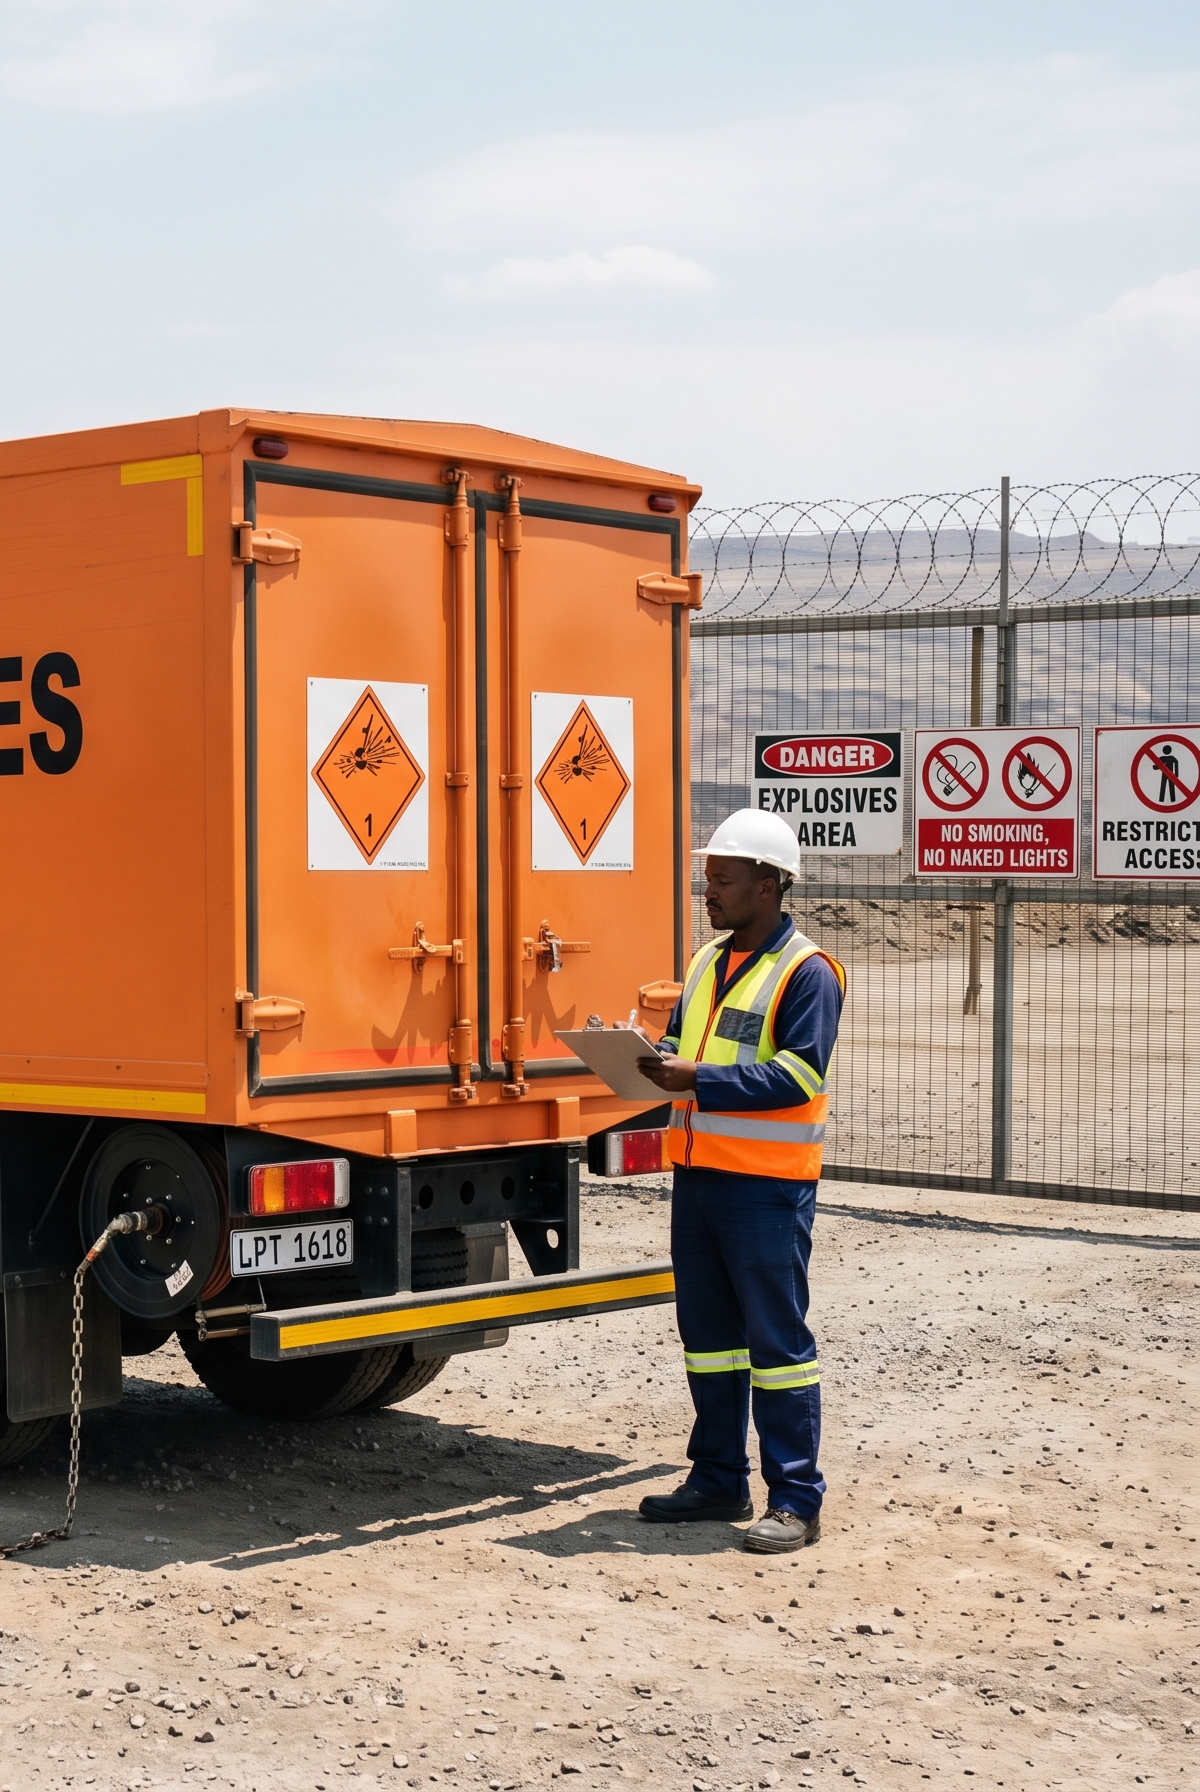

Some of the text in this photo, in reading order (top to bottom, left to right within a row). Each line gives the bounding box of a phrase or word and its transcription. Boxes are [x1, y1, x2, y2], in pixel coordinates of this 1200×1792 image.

[780, 745, 876, 768] DANGER
[758, 786, 898, 814] EXPLOSIVES
[364, 813, 373, 837] 1
[580, 818, 587, 840] 1
[798, 821, 857, 847] AREA
[940, 823, 1050, 845] NO SMOKING,
[923, 847, 1069, 867] NO NAKED LIGHTS
[1124, 848, 1200, 869] ACCES
[239, 1228, 347, 1269] LPT 1618
